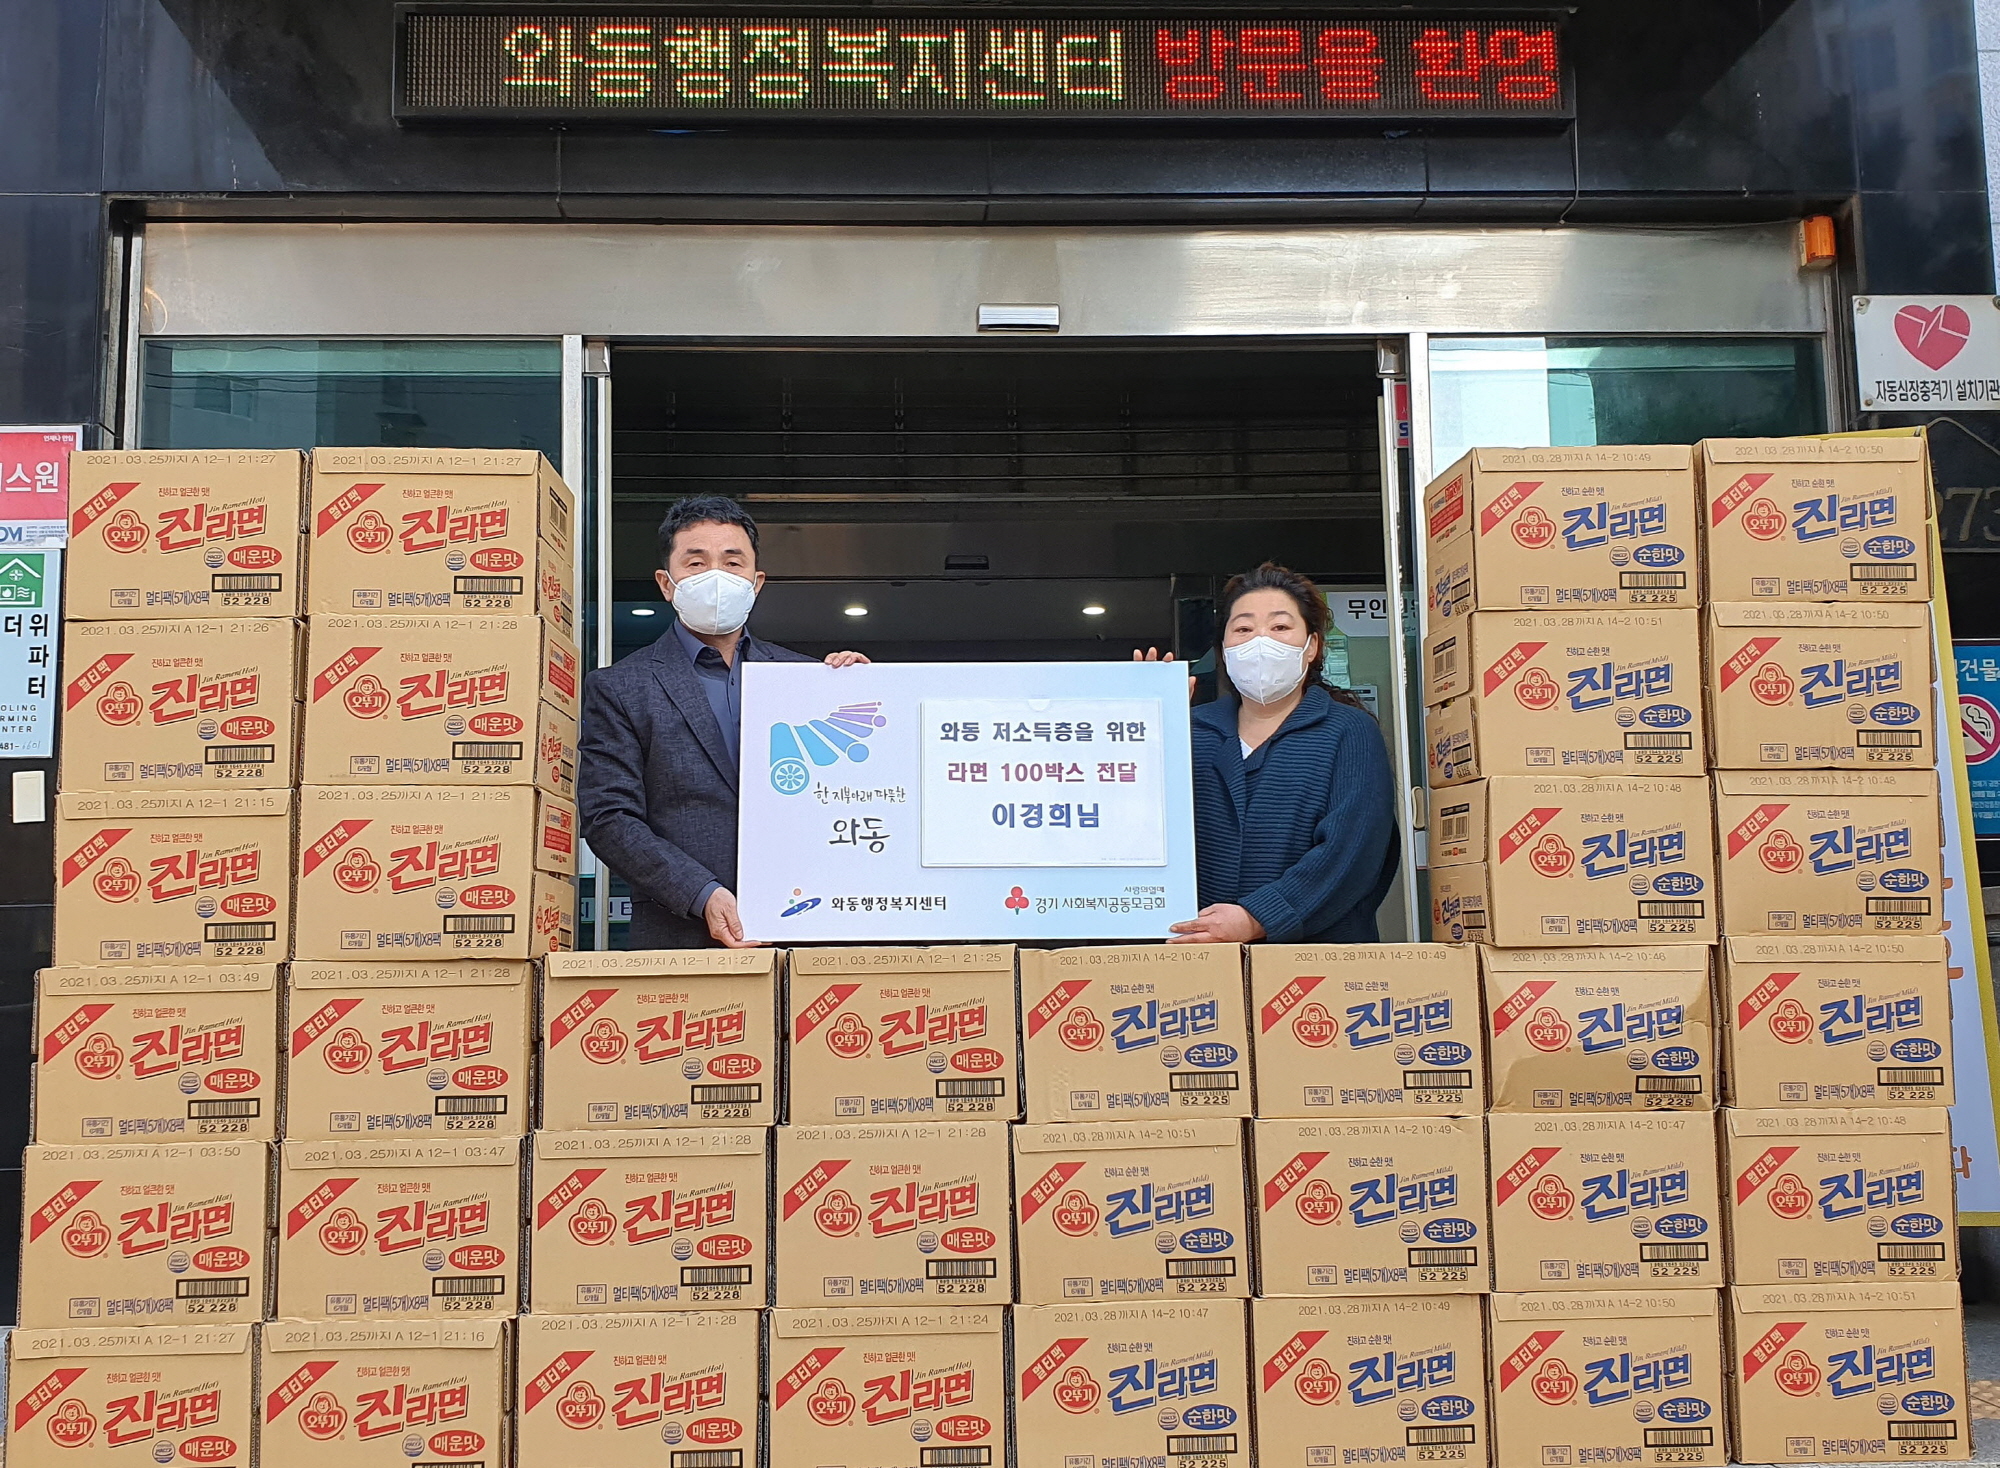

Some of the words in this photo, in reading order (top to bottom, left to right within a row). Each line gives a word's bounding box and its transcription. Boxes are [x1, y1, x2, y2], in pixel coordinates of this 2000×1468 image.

[503, 25, 1124, 101] 와동행정복지센터
[1157, 28, 1386, 101] 방문을
[1412, 28, 1558, 101] 환영
[1875, 379, 1954, 402] 자동심장충격기
[1956, 379, 2000, 402] 설치기관
[237, 454, 276, 464] 21:27
[0, 461, 60, 493] 스원
[156, 503, 266, 554] 진라면
[399, 505, 508, 557] 진라면
[1561, 502, 1666, 552] 진라면
[1750, 519, 1778, 530] 오뚜기
[1792, 494, 1896, 543] 진라면
[234, 548, 276, 564] 매운맛
[1638, 547, 1680, 562] 순한맛
[1868, 539, 1910, 554] 순한맛
[77, 660, 111, 692] 멀티팩
[1954, 658, 2000, 682] 건물
[397, 669, 508, 722] 진라면
[1566, 662, 1672, 713] 진라면
[1799, 659, 1901, 709] 진라면
[149, 673, 259, 726] 진라면
[227, 719, 269, 736] 매운맛
[475, 716, 518, 732] 매운맛
[1644, 708, 1686, 723] 순한맛
[940, 721, 980, 742] 와동
[992, 721, 1094, 742] 저소득층을
[1106, 721, 1146, 742] 위한
[948, 762, 988, 783] 라면
[1000, 762, 1085, 783] 100박스
[1096, 762, 1138, 783] 전달
[470, 790, 511, 802] 21:25
[992, 802, 1100, 829] 이경희님
[828, 816, 891, 854] 와동
[1581, 829, 1685, 880] 진라면
[1808, 826, 1911, 876] 진라면
[147, 849, 260, 903] 진라면
[387, 841, 499, 895] 진라면
[466, 888, 509, 905] 매운맛
[1657, 876, 1699, 891] 순한맛
[227, 896, 270, 913] 매운맛
[831, 895, 947, 911] 와동행정복지센터
[1035, 896, 1058, 914] 경기
[1416, 950, 1447, 961] 10:49
[806, 991, 840, 1023] 멀티팩
[1819, 995, 1922, 1046] 진라면
[634, 1009, 745, 1064] 진라면
[878, 1004, 987, 1059] 진라면
[1111, 1000, 1217, 1052] 진라면
[1344, 998, 1452, 1050] 진라면
[1577, 1003, 1683, 1055] 진라면
[130, 1024, 244, 1079] 진라면
[378, 1020, 492, 1075] 진라면
[589, 1040, 619, 1053] 오뚜기
[956, 1052, 998, 1068] 매운맛
[1189, 1047, 1232, 1062] 순한맛
[1423, 1045, 1466, 1060] 순한맛
[713, 1057, 756, 1074] 매운맛
[210, 1072, 254, 1089] 매운맛
[947, 1127, 987, 1139] 21:28
[1746, 1154, 1778, 1186] 멀티팩
[1349, 1173, 1457, 1227] 진라면
[1581, 1169, 1688, 1223] 진라면
[1818, 1169, 1923, 1222] 진라면
[622, 1189, 735, 1246] 진라면
[867, 1181, 979, 1238] 진라면
[1105, 1183, 1213, 1237] 진라면
[117, 1201, 233, 1258] 진라면
[328, 1231, 359, 1243] 오뚜기
[374, 1199, 489, 1256] 진라면
[1428, 1222, 1471, 1238] 순한맛
[1660, 1218, 1702, 1233] 순한맛
[1896, 1217, 1938, 1233] 순한맛
[702, 1238, 746, 1256] 매운맛
[947, 1231, 990, 1248] 매운맛
[1185, 1232, 1229, 1248] 순한맛
[199, 1250, 244, 1268] 매운맛
[455, 1249, 499, 1266] 매운맛
[194, 1332, 236, 1345] 21:27
[1274, 1338, 1307, 1371] 멀티팩
[1347, 1351, 1455, 1406] 진라면
[1583, 1353, 1691, 1407] 진라면
[1826, 1345, 1935, 1399] 진라면
[861, 1369, 974, 1426] 진라면
[1063, 1389, 1092, 1401] 오뚜기
[1107, 1359, 1217, 1414] 진라면
[353, 1383, 468, 1441] 진라면
[611, 1372, 726, 1429] 진라면
[1426, 1399, 1469, 1415] 순한맛
[1906, 1394, 1950, 1410] 순한맛
[103, 1389, 220, 1447] 진라면
[942, 1419, 985, 1436] 매운맛
[1188, 1408, 1231, 1424] 순한맛
[692, 1421, 737, 1439] 매운맛
[185, 1440, 230, 1458] 매운맛
